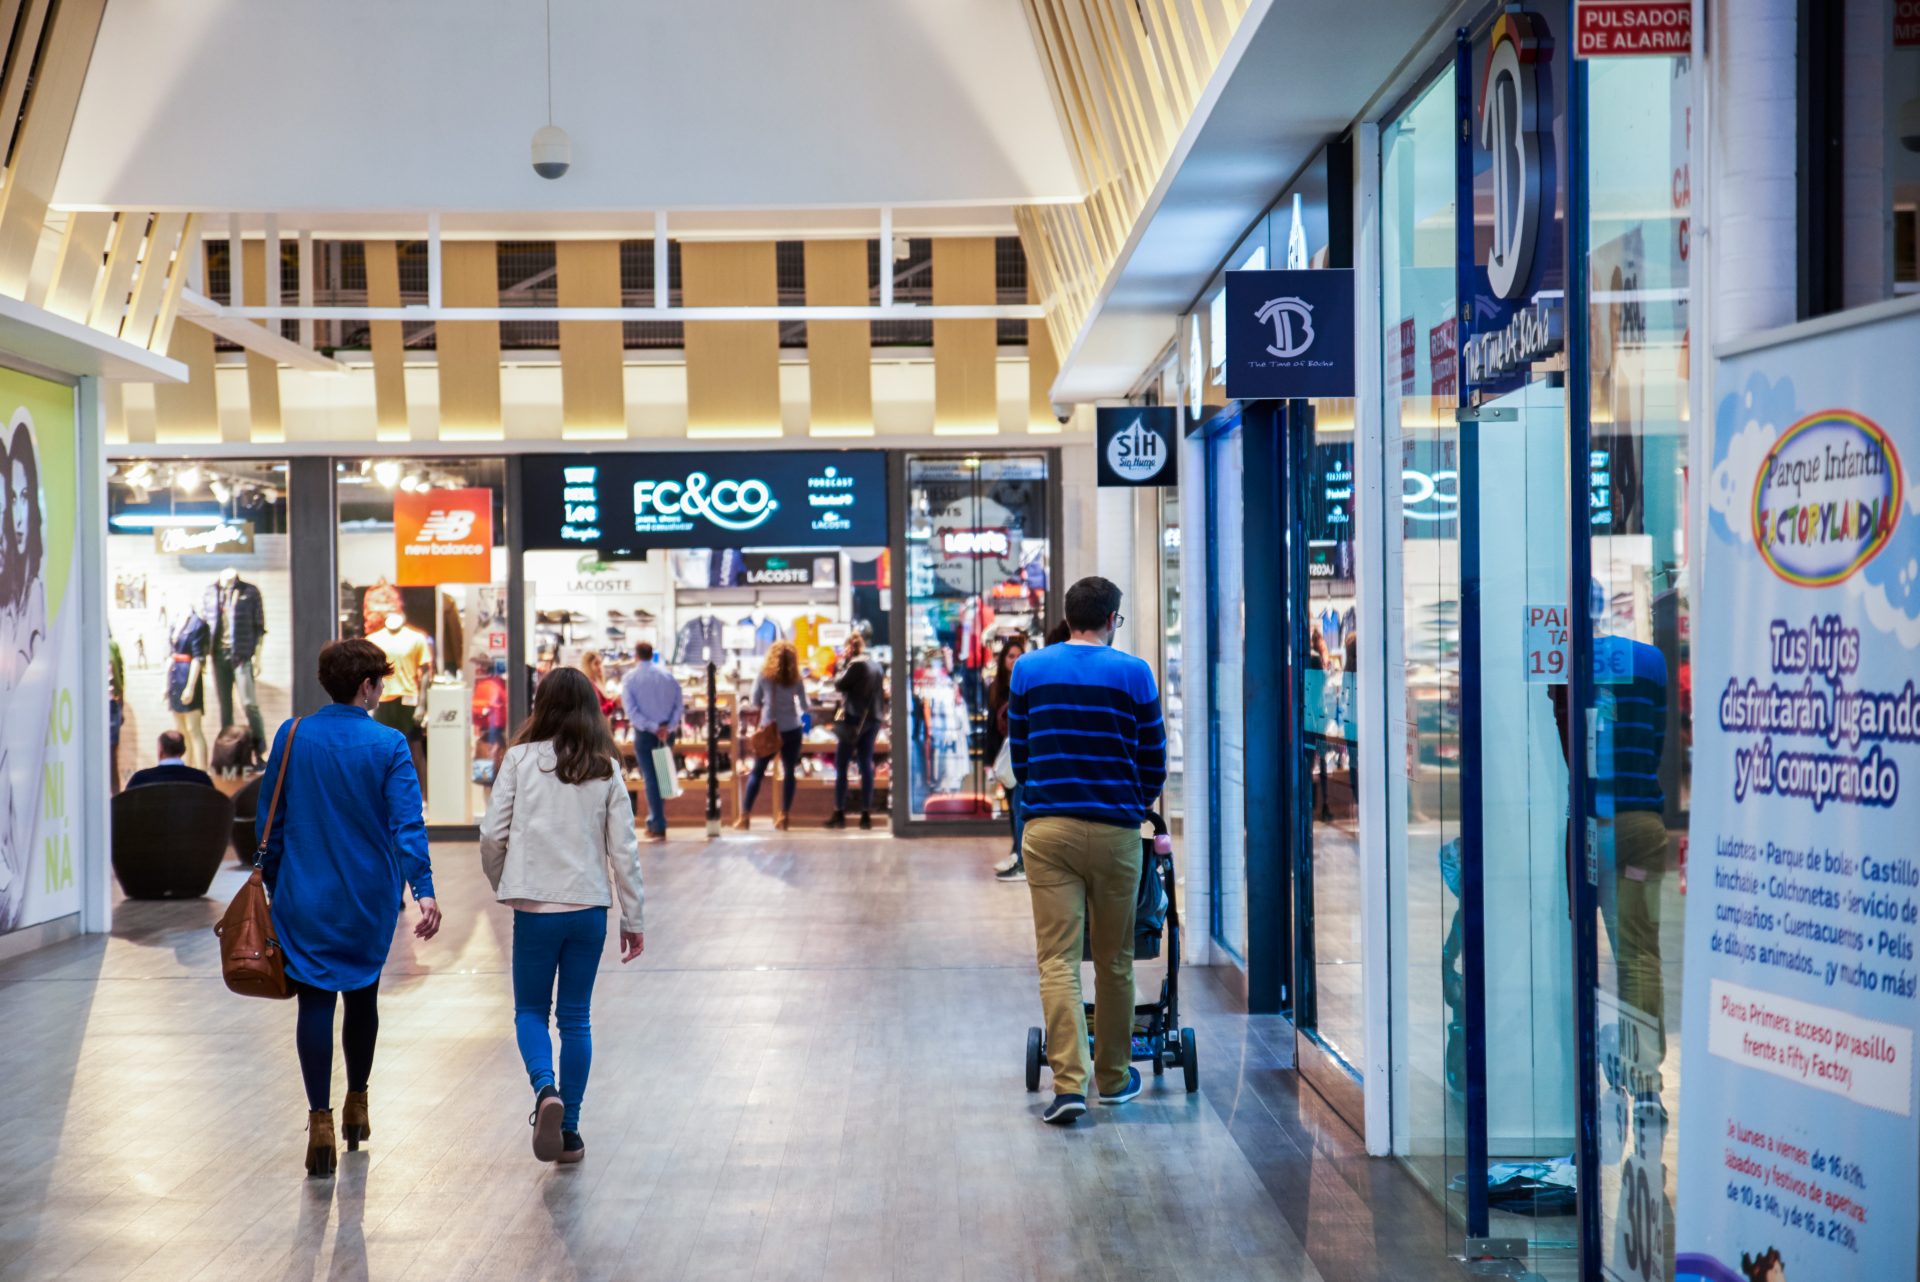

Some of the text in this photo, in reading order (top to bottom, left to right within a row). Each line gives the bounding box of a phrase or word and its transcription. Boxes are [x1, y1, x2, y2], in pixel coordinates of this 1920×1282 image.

[1581, 31, 1692, 49] DE ALARMA
[1585, 9, 1691, 28] PULSADOR
[1247, 361, 1267, 369] The
[1463, 341, 1480, 384] The
[1481, 331, 1503, 378] Time
[1767, 435, 1886, 499] Parque Infantil
[1758, 496, 1890, 549] FACTORYLANDIA
[404, 542, 485, 556] new balance
[567, 579, 632, 593] LACOSTE
[746, 569, 809, 583] LACOSTE
[1770, 614, 1860, 685] Tus hijos
[1719, 677, 1828, 736] disfrutarán
[1735, 737, 1898, 812] y tú comprando
[1766, 841, 1805, 873] Parque
[1806, 846, 1822, 873] de
[1861, 855, 1920, 888] Castillo
[1768, 875, 1841, 910] Colchonetas
[1901, 896, 1919, 925] de
[1711, 929, 1723, 951] de
[1881, 968, 1918, 1000] más!
[1877, 930, 1914, 961] Pelis
[1794, 1020, 1833, 1046] acceso
[1736, 1121, 1766, 1149] lunes
[1811, 1148, 1827, 1173] de
[1726, 1180, 1739, 1202] de
[1740, 1184, 1754, 1207] 10
[1754, 1193, 1762, 1210] a
[1790, 1204, 1803, 1229] de
[1816, 1220, 1826, 1239] a
[1808, 1180, 1823, 1204] de
